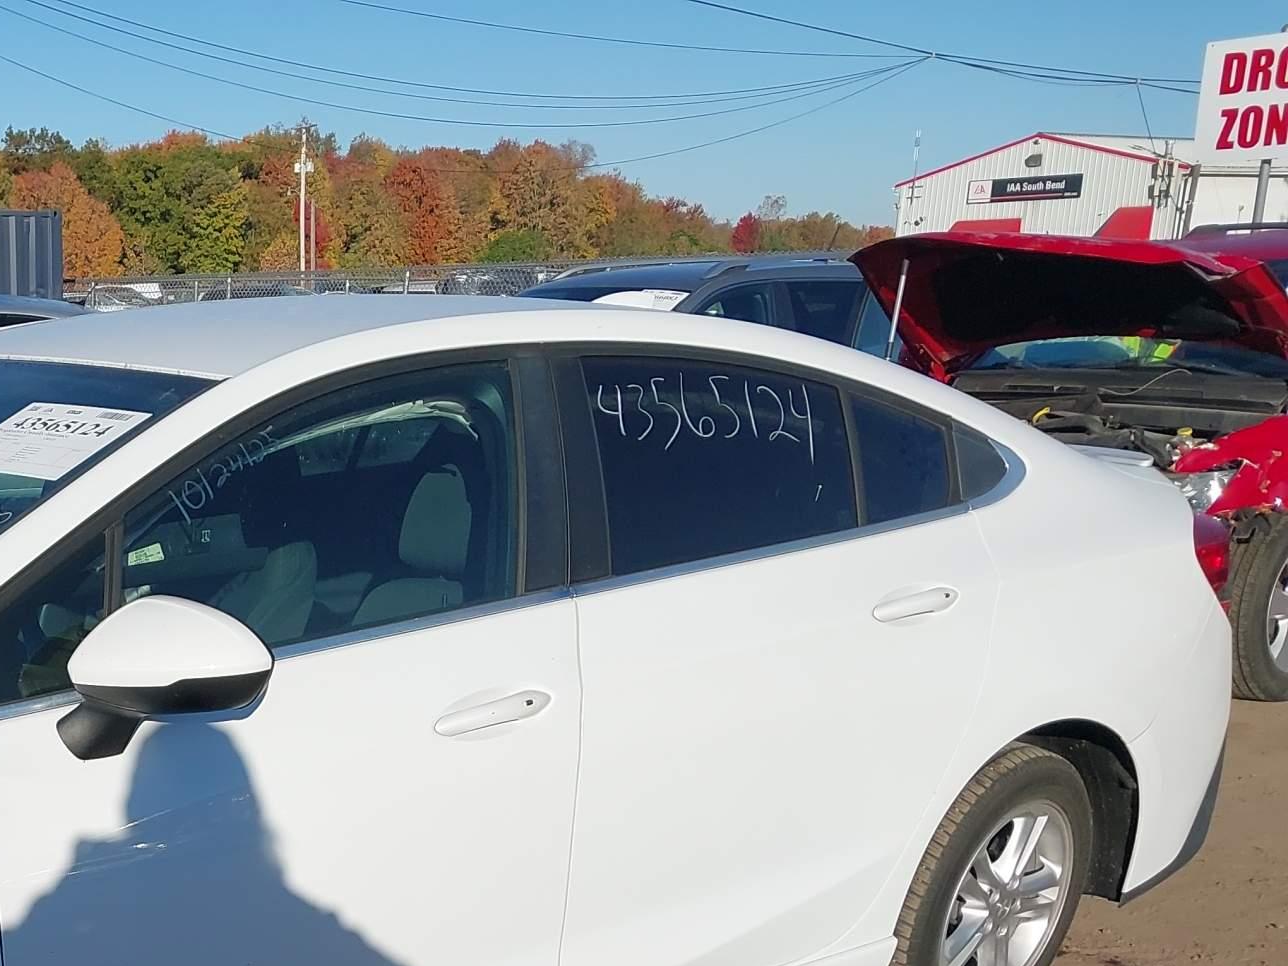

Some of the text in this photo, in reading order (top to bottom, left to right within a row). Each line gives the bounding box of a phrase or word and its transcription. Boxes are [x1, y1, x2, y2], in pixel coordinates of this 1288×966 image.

[1006, 179, 1066, 193] IAA South Bend
[13, 416, 113, 438] 43565124
[597, 370, 815, 465] 43565124
